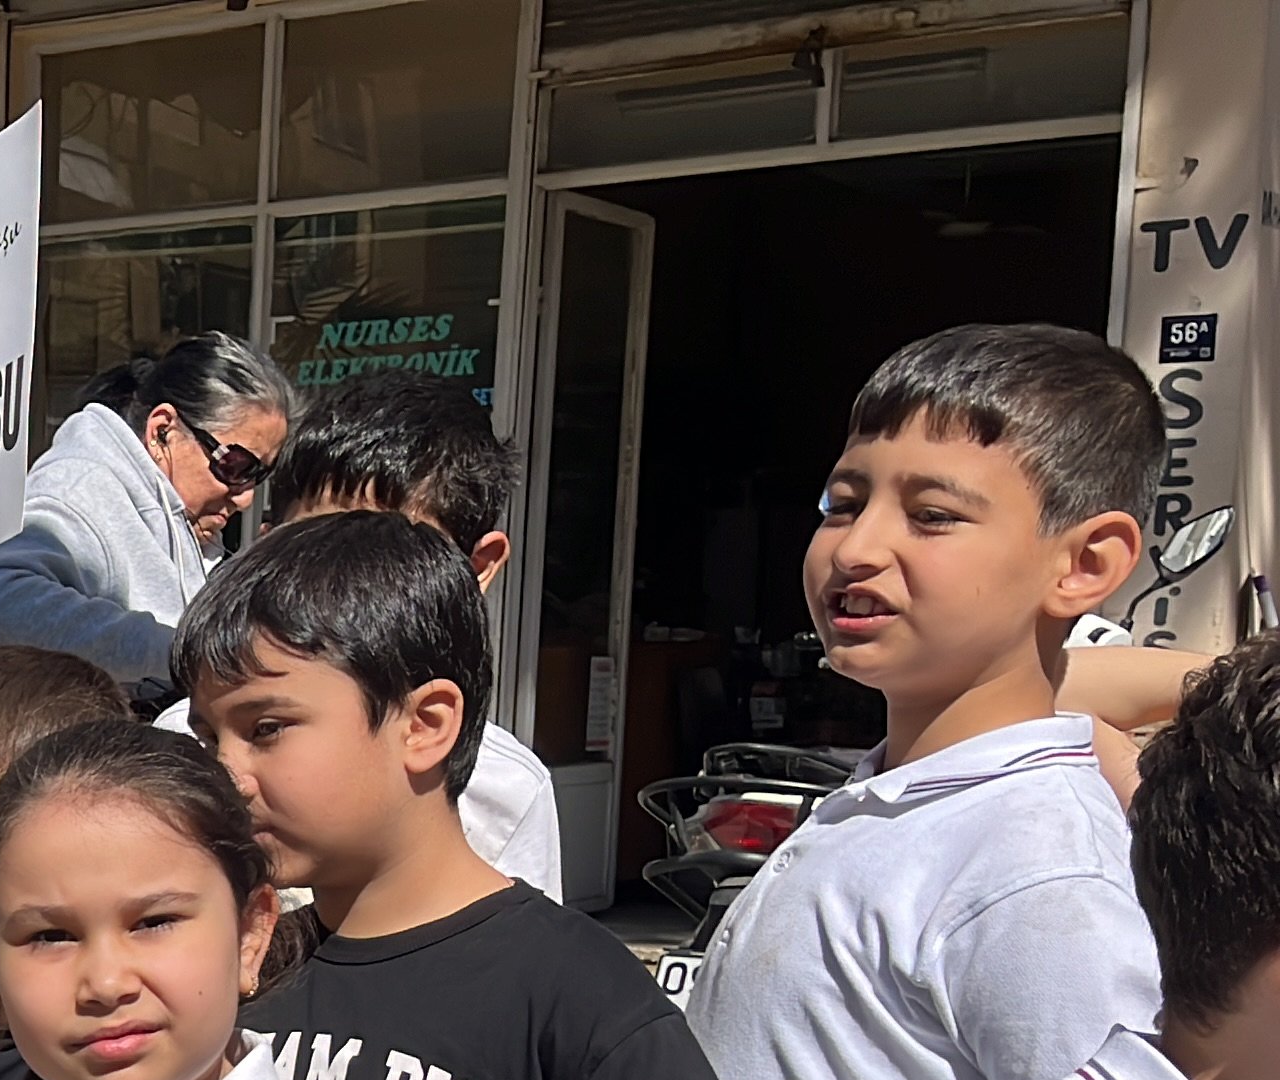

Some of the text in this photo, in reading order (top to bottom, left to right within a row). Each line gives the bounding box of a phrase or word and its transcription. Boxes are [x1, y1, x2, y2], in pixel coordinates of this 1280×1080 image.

[1140, 213, 1250, 273] TV
[315, 313, 454, 349] NURSES
[663, 961, 687, 996] 0
